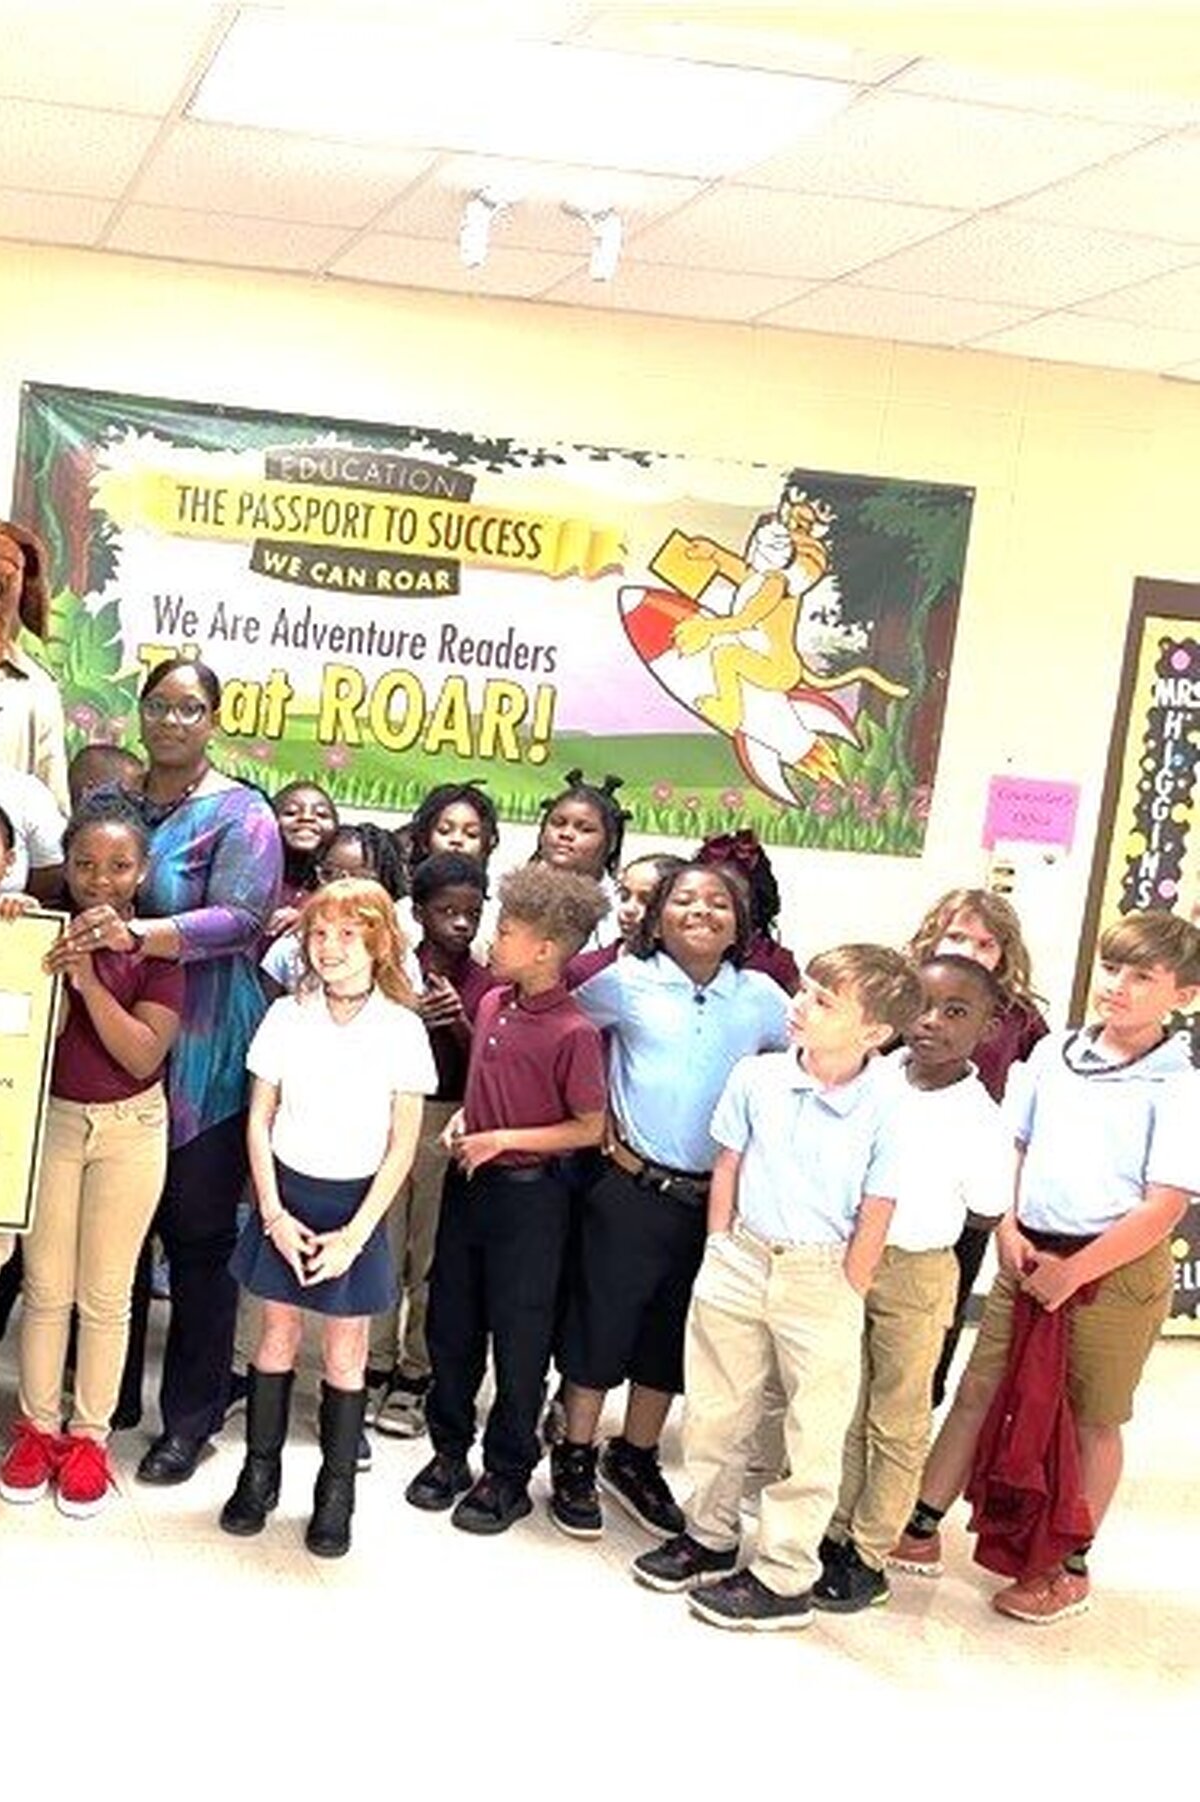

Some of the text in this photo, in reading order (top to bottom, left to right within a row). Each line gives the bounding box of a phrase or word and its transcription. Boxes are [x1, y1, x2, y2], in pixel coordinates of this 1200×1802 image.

[279, 455, 461, 498] EDUCATION
[176, 484, 544, 562] THE PASSPORT TO SUCCESS
[263, 550, 452, 592] WE CAN ROAR
[153, 594, 559, 674] We Are Adventure Readers
[137, 643, 558, 766] Tat ROAR!
